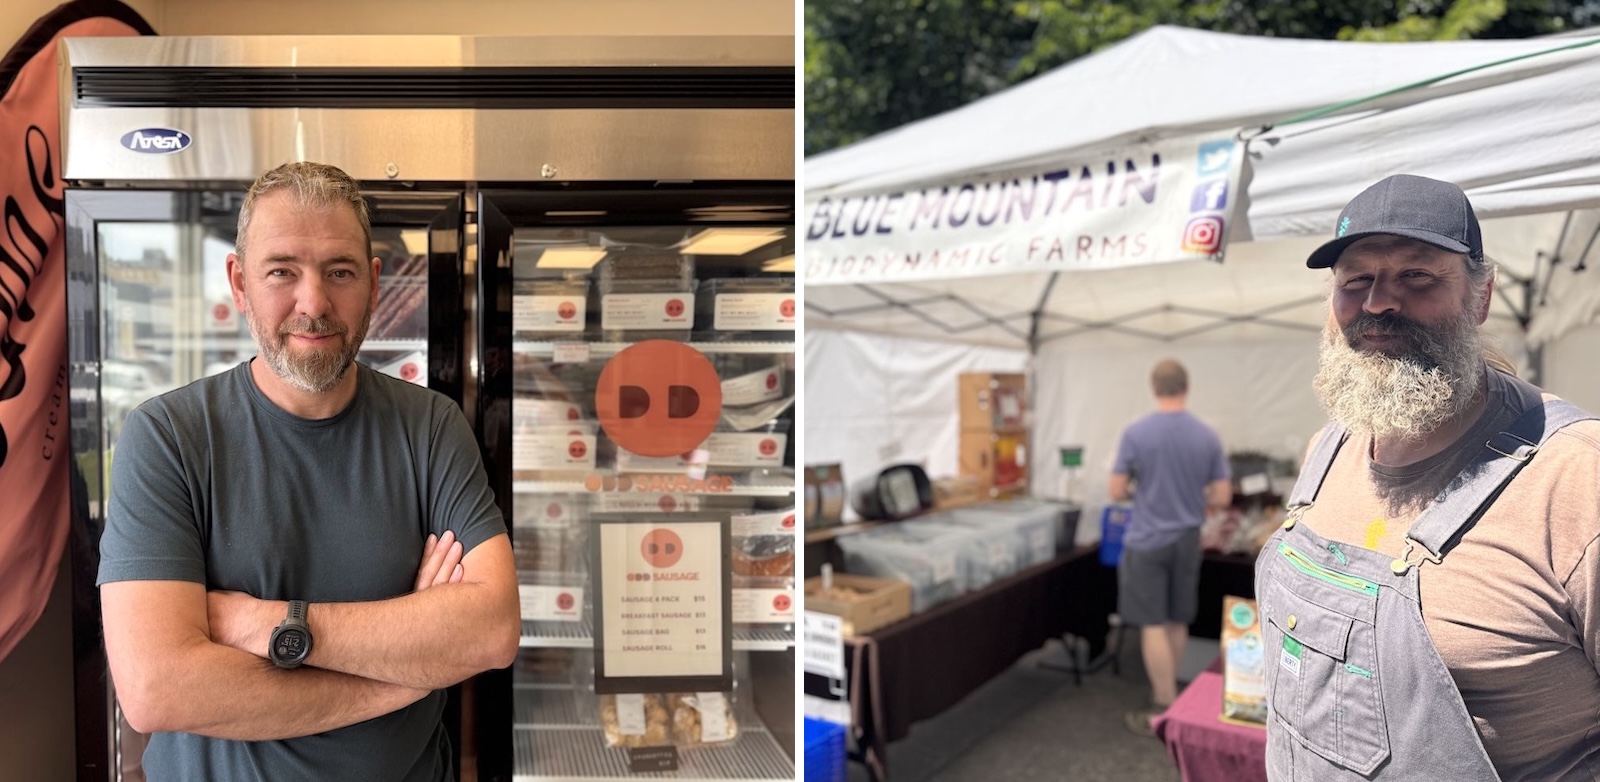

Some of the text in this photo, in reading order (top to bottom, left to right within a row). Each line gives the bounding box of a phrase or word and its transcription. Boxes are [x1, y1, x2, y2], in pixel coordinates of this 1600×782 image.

[806, 153, 1162, 241] BLUE MOUNTAIN
[805, 232, 1148, 278] BIODYNAMIC FARMS
[42, 364, 66, 460] cream
[635, 474, 733, 493] SAUSAGE
[653, 571, 700, 581] SAUSAGE
